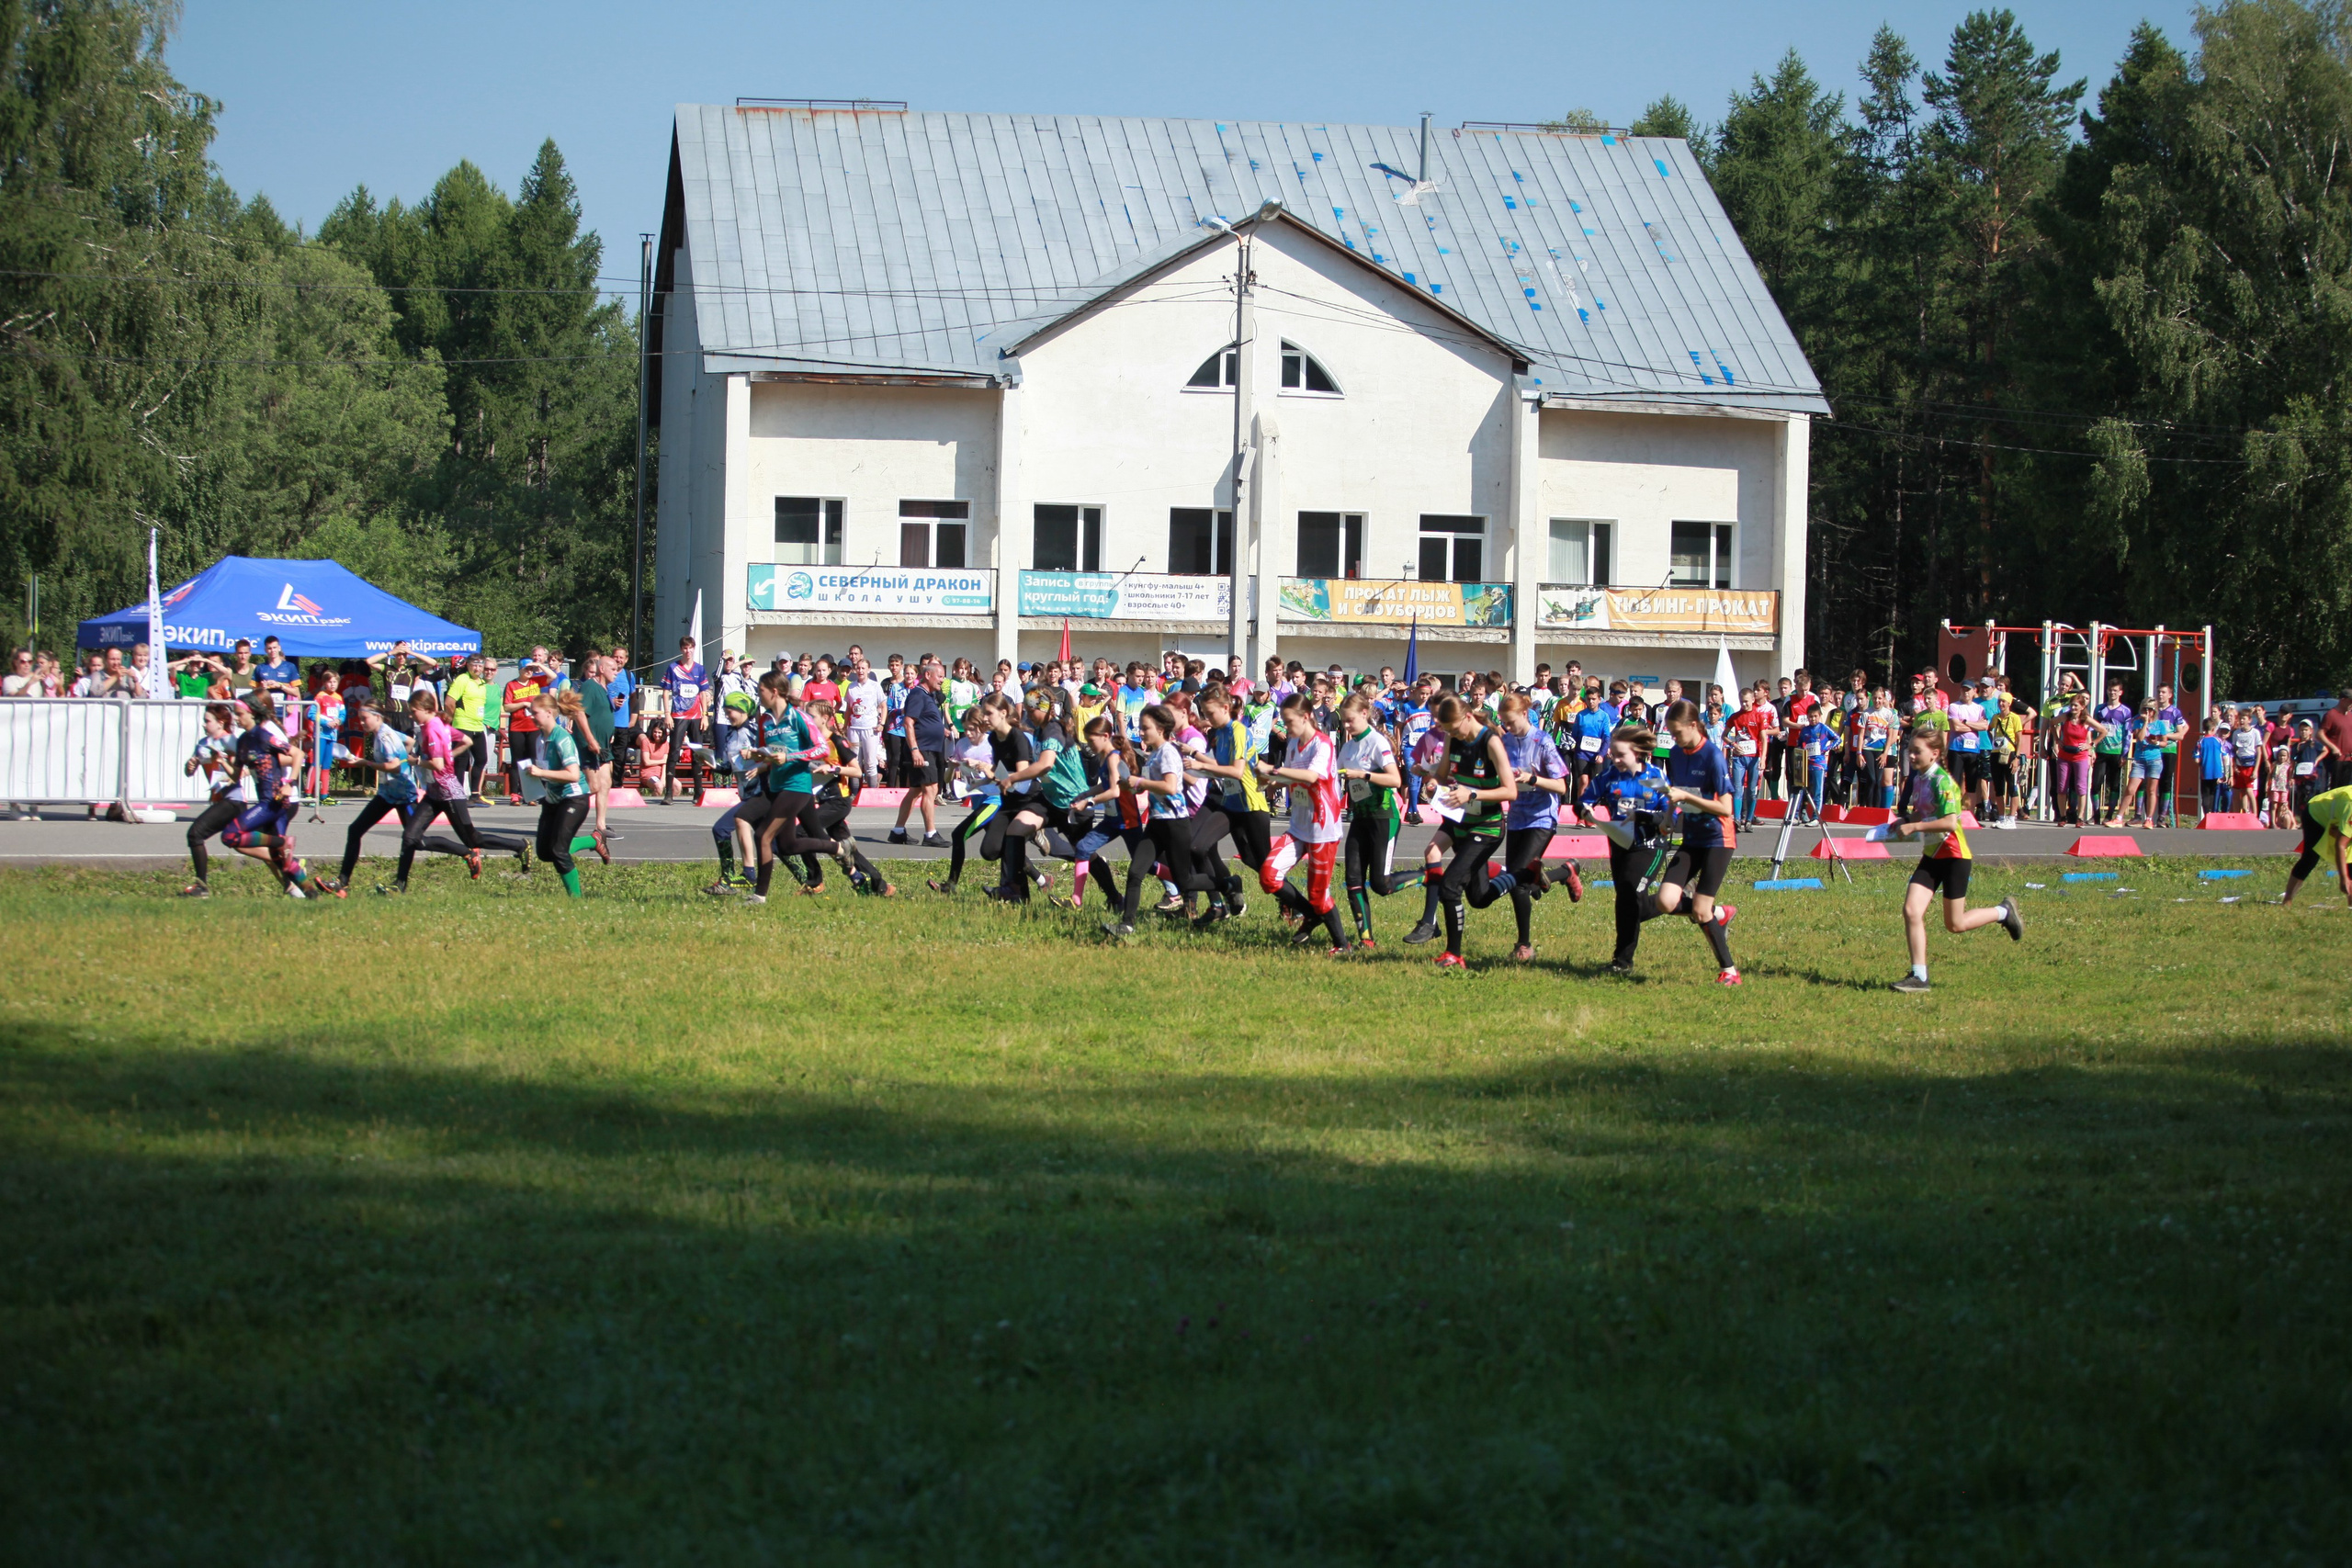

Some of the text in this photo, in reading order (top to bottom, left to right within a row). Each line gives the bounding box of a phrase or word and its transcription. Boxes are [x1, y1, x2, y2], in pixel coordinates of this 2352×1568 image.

[819, 574, 981, 592] СЕВЕРНЫЙ ДРАКОН
[1024, 575, 1070, 588] Запись
[818, 593, 933, 604] ШКОЛА УШУ
[1024, 591, 1080, 604] круглый
[1344, 587, 1451, 603] ПРОКАТ ЛЫЖ
[1338, 603, 1457, 619] И СНОУБОРДОВ
[1613, 597, 1770, 616] ТЮБИНГ-ПРОКАТ
